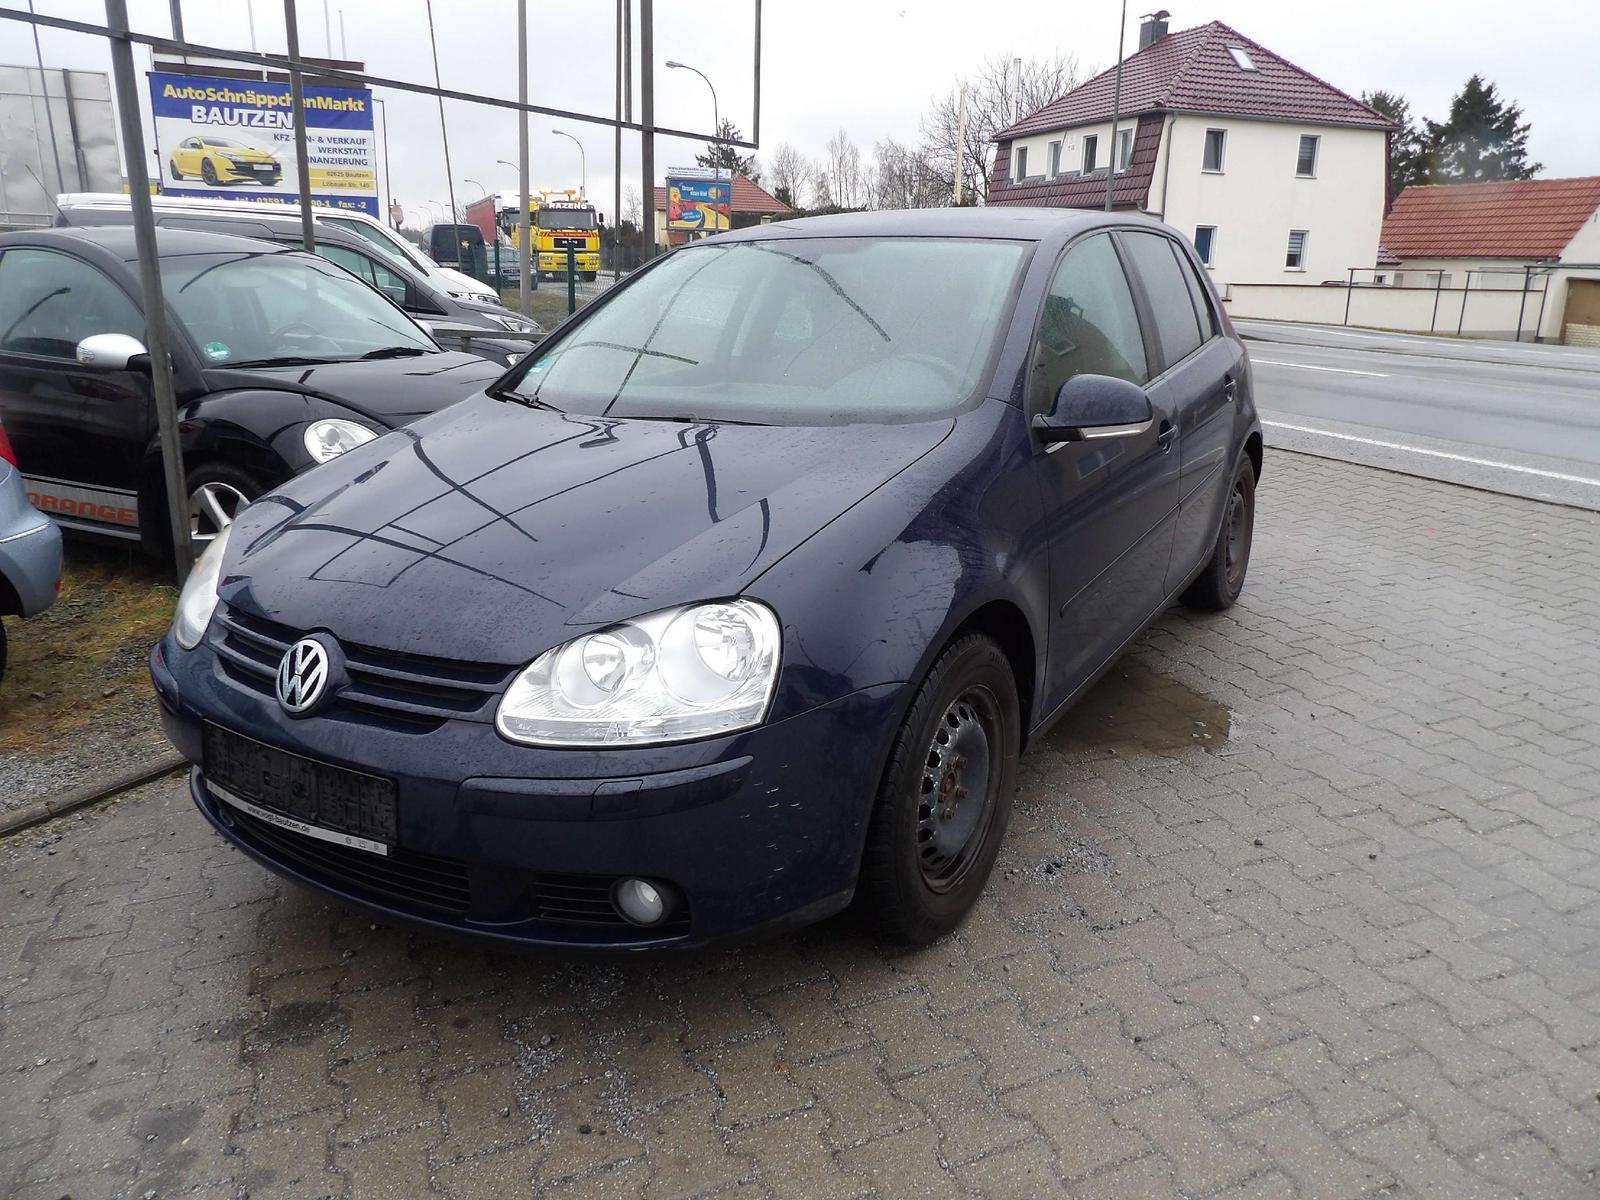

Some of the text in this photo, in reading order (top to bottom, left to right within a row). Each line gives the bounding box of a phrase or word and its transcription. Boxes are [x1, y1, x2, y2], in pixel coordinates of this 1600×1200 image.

[163, 83, 365, 112] AutoSchnäppchnMarkt
[190, 105, 294, 129] BAUTZEN
[273, 133, 290, 141] KFZ
[327, 137, 367, 145] VERKAUF
[317, 147, 368, 155] WERKSTATT
[307, 156, 368, 166] INANZIERUNG
[26, 492, 137, 523] ORANGE
